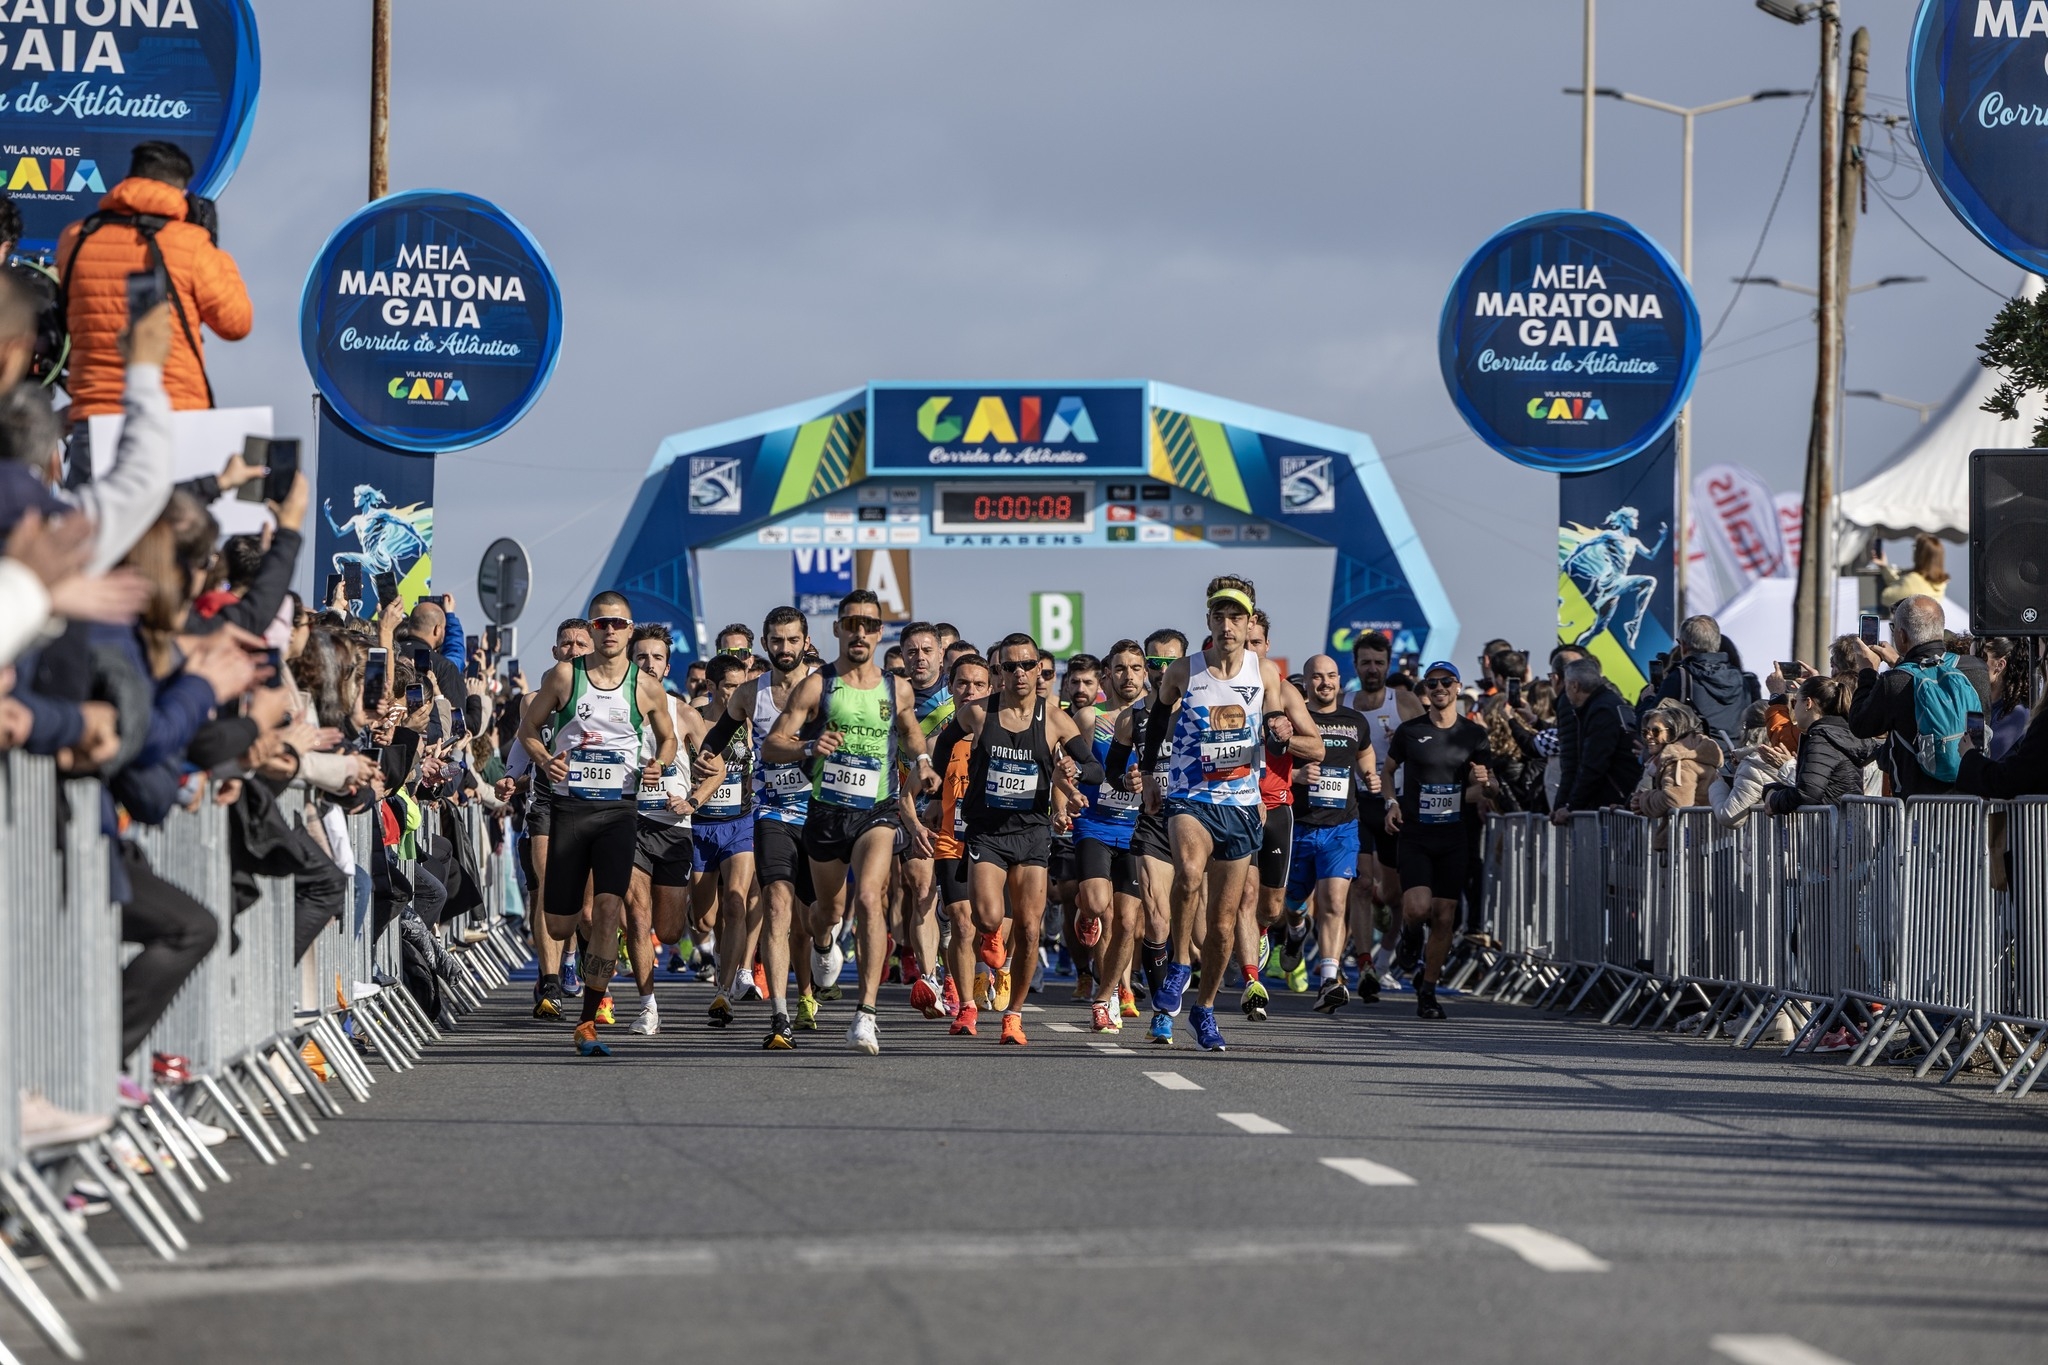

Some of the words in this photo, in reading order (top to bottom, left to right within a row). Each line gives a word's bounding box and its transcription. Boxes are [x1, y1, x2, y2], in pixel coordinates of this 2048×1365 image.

[0, 0, 199, 29] ATONA
[0, 28, 126, 74] AIA
[15, 82, 51, 113] do
[52, 80, 191, 119] Atlântico
[3, 145, 29, 155] VILA
[30, 146, 62, 156] NOVA
[65, 147, 81, 157] DE
[0, 157, 107, 193] AIA
[38, 193, 75, 201] MUNICIPAL
[396, 243, 471, 271] MEIA
[338, 270, 526, 302] MARATONA
[1532, 264, 1607, 290] MEIA
[381, 298, 481, 329] GAIA
[1475, 292, 1664, 319] MARATONA
[339, 326, 410, 351] Corrida
[413, 333, 437, 352] do
[437, 331, 521, 356] Atlântico
[1518, 318, 1619, 347] GAIA
[1477, 348, 1549, 373] Corrida
[1551, 352, 1574, 372] do
[1574, 350, 1660, 375] Atlântico
[422, 371, 442, 379] NOVA
[387, 377, 469, 401] GAIA
[1581, 391, 1593, 399] DE
[917, 396, 1099, 443] GAIA
[1526, 397, 1609, 420] GAIA
[928, 446, 991, 464] Corrida
[993, 448, 1013, 463] do
[1013, 446, 1088, 465] Atlântico
[974, 495, 1072, 521] 0:00:08
[794, 548, 852, 574] VIP
[866, 548, 905, 614] A
[1040, 593, 1074, 652] B
[991, 745, 1034, 761] PORTUGAL
[1214, 745, 1242, 760] 7197
[570, 772, 581, 780] VIP
[583, 766, 611, 780] 3616
[775, 771, 803, 786] 3161
[824, 773, 834, 782] VIP
[836, 769, 866, 787] 3618
[998, 776, 1026, 791] 1021
[712, 788, 731, 799] 339
[1110, 788, 1136, 803] 2057
[1320, 780, 1342, 792] 3606
[1430, 797, 1453, 808] 3706
